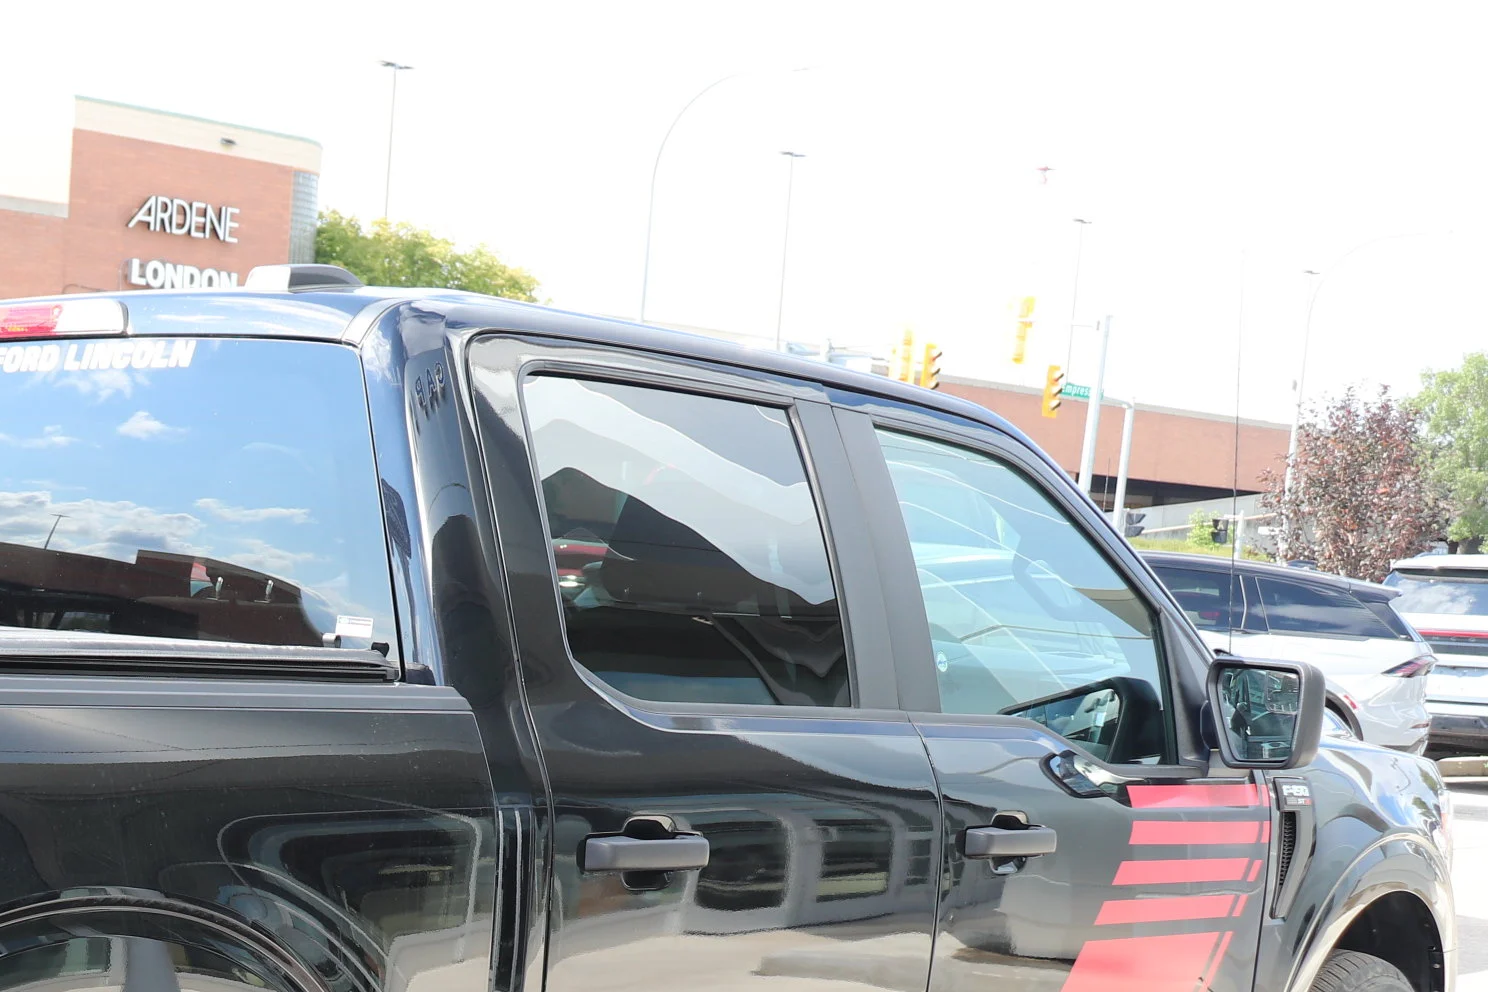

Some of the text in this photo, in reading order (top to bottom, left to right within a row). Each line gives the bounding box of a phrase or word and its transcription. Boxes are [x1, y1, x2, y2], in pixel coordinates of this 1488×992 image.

[126, 195, 240, 243] ARDENE
[130, 258, 238, 288] LONDON
[64, 340, 196, 371] LINCOLN
